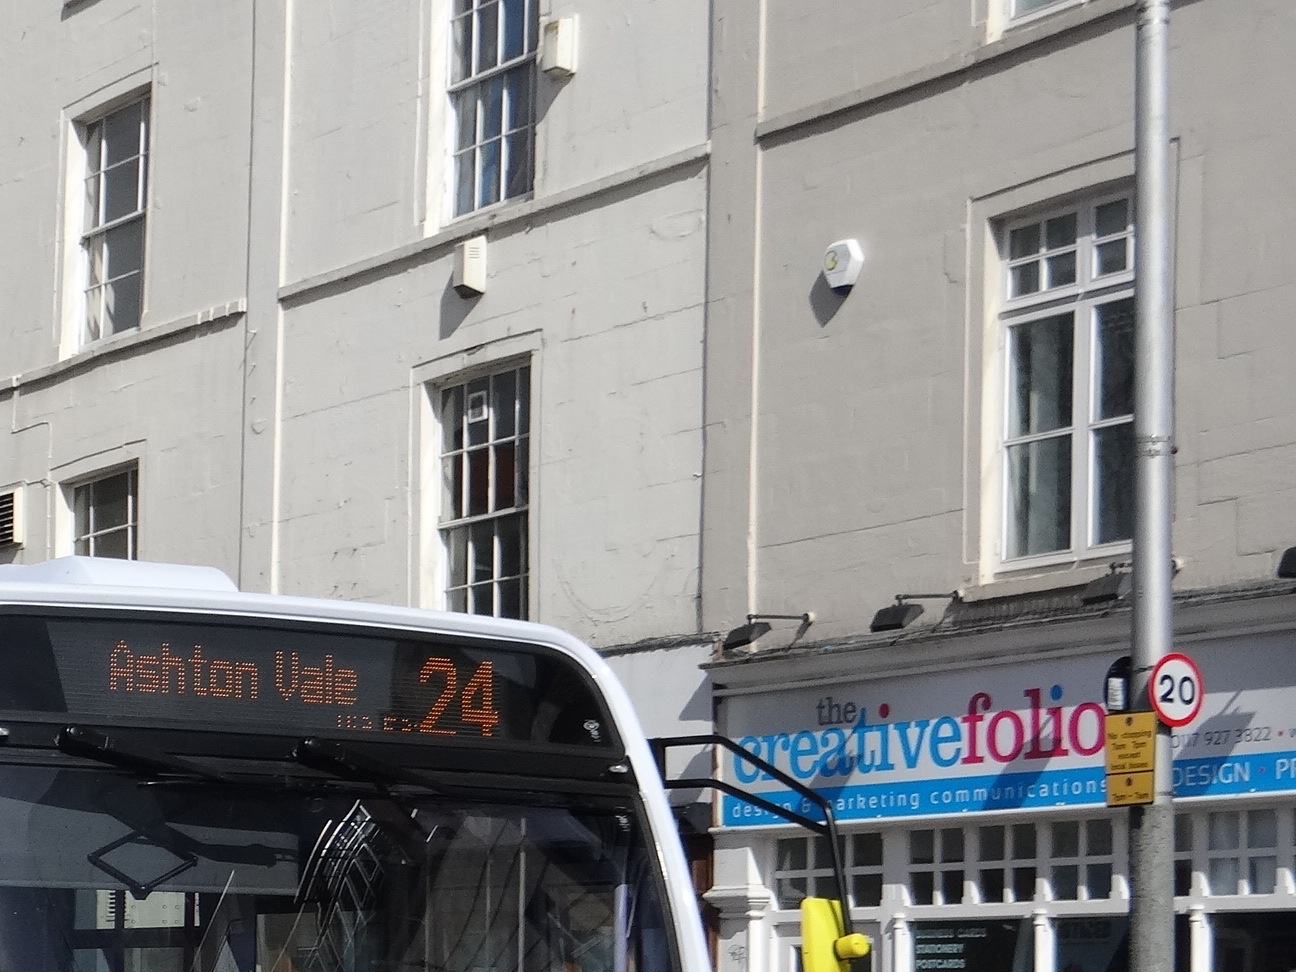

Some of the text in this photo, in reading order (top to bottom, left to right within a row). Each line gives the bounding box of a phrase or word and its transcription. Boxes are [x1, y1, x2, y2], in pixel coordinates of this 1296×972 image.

[109, 640, 358, 706] Ashton Vale
[419, 656, 499, 737] 24
[1159, 674, 1195, 705] 20
[816, 697, 857, 726] the
[825, 792, 920, 811] arketing
[915, 959, 966, 969] POSTCARDS
